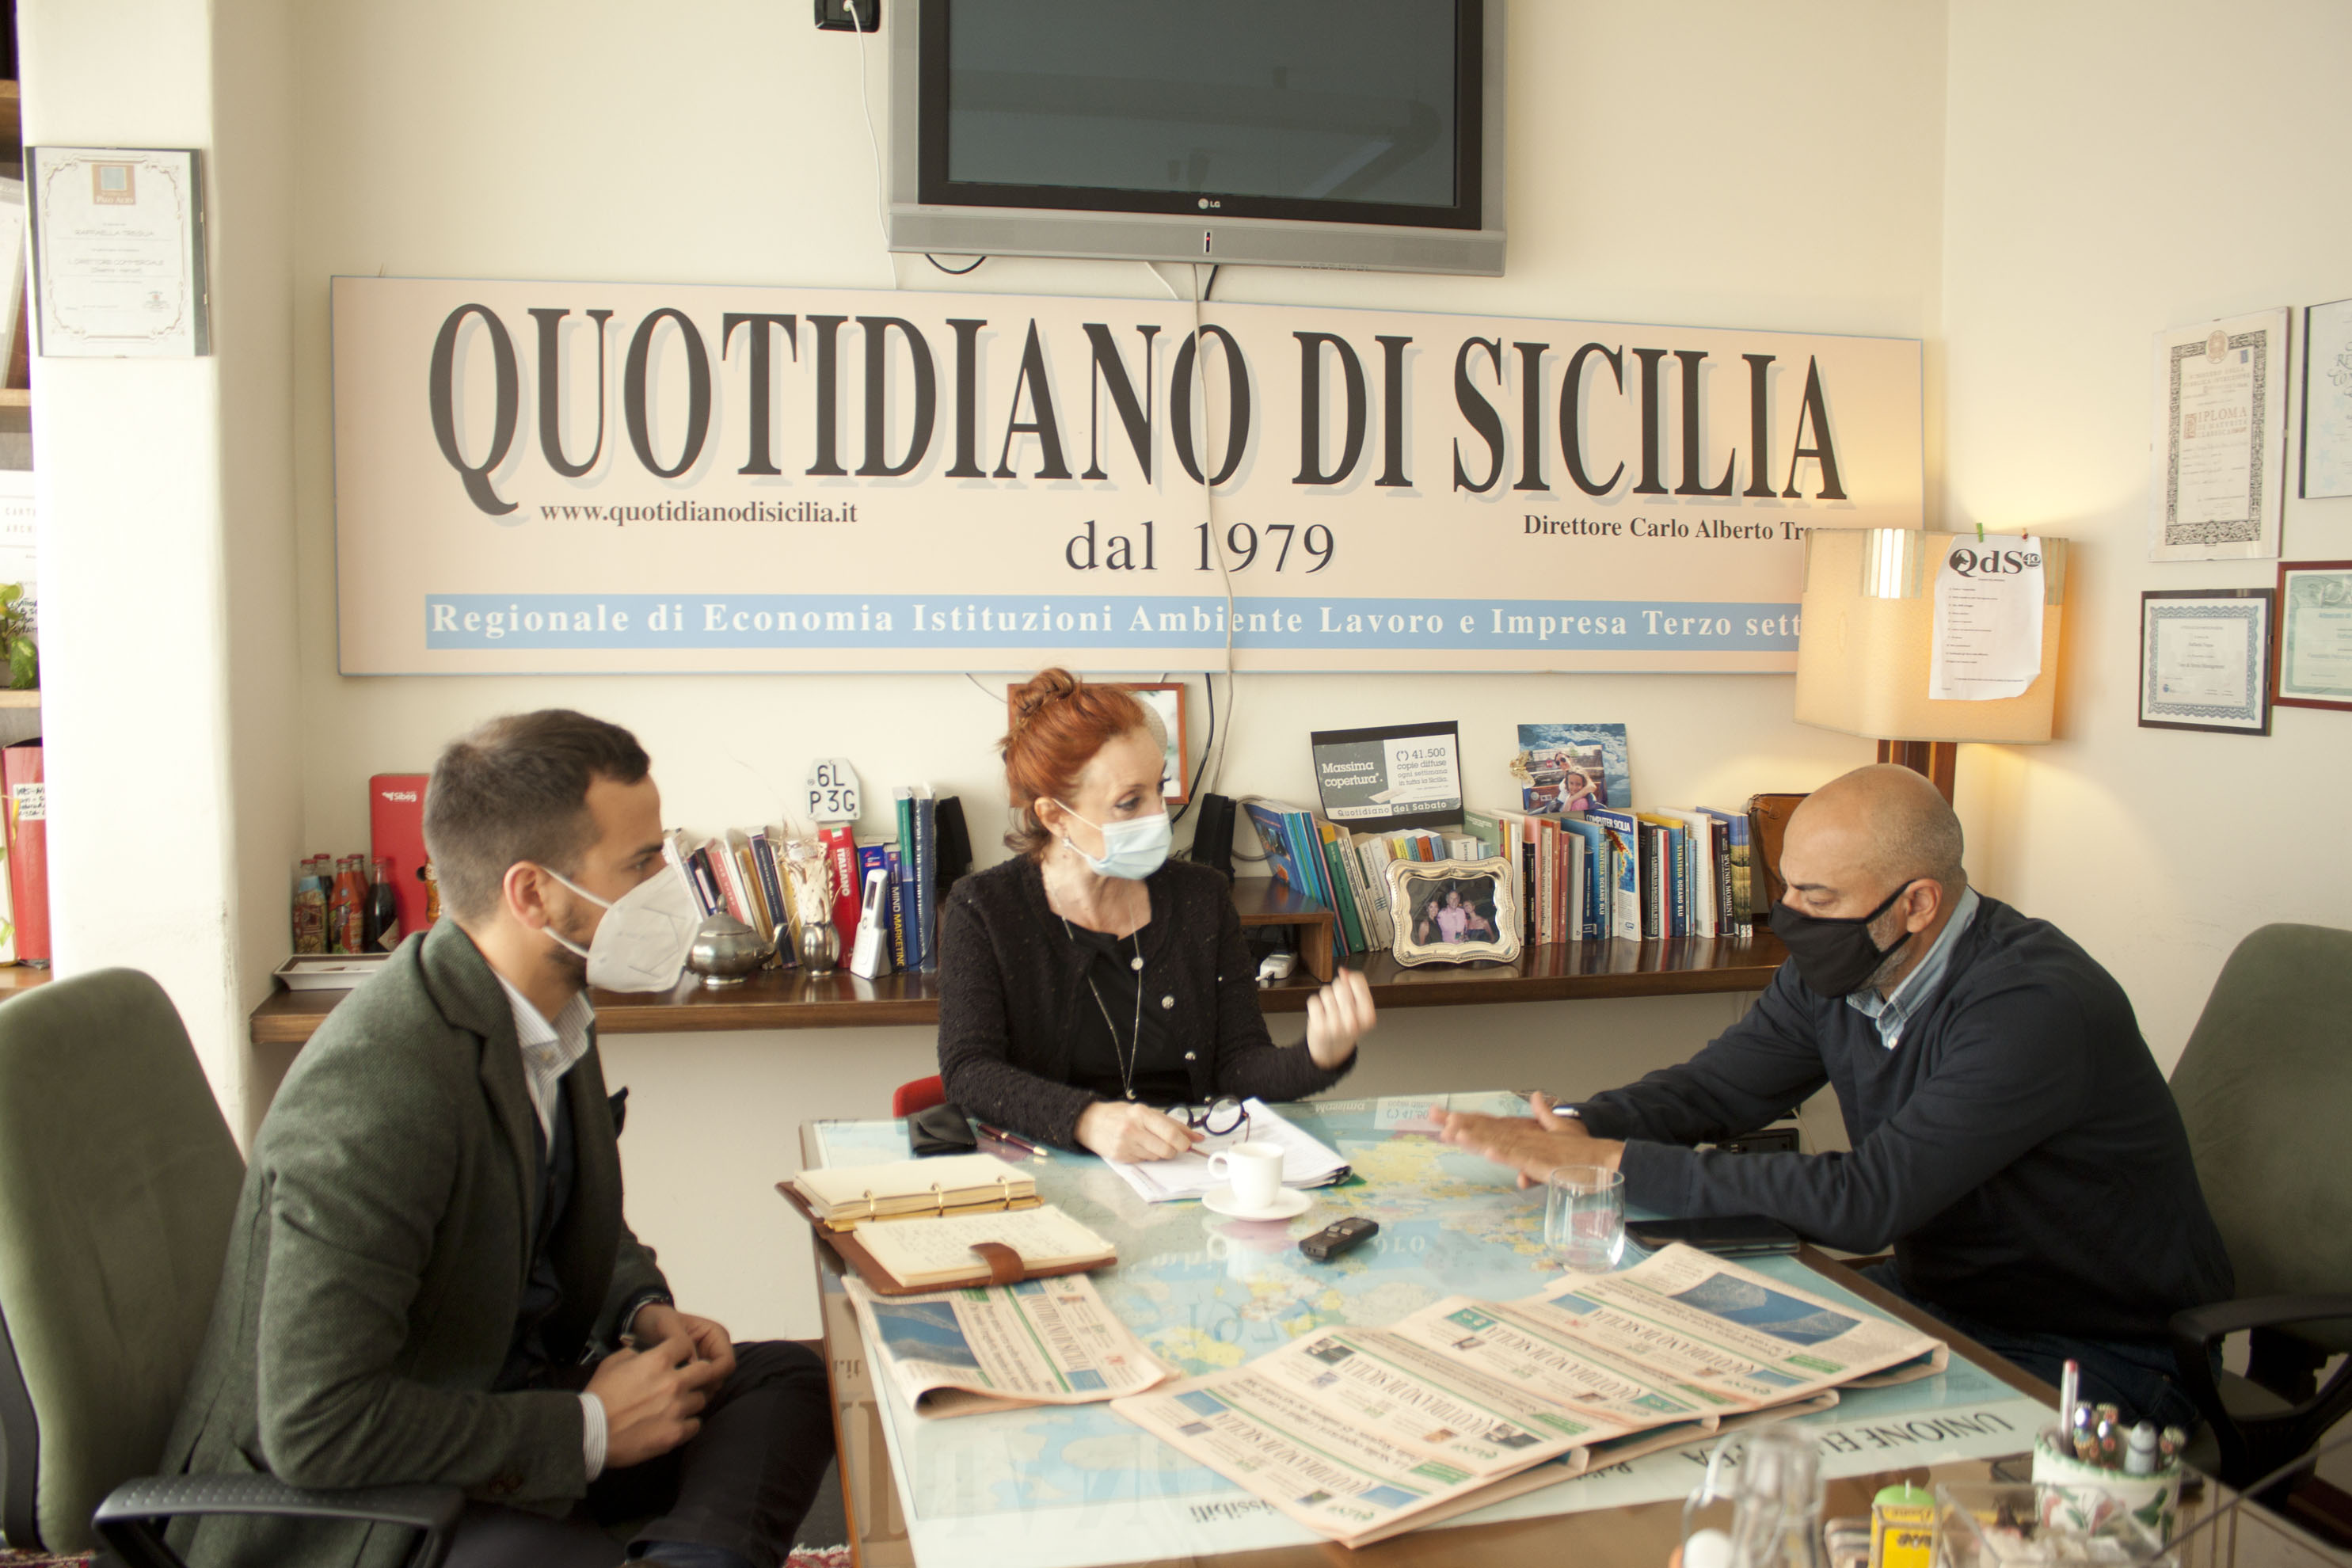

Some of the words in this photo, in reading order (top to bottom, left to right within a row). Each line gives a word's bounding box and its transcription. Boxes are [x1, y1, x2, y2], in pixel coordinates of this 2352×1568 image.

[429, 303, 1251, 516] QUOTIDIANO
[1292, 330, 1413, 489] DI
[1452, 337, 1848, 500] SICILIA
[539, 501, 858, 527] www.quotidianodisicilia.it
[1523, 514, 1622, 538] Direttore
[1629, 516, 1689, 539] Carlo
[1695, 519, 1773, 540] Alberto
[1065, 519, 1158, 571] dal
[1193, 521, 1335, 574] 1979
[1949, 547, 2023, 577] QdS
[431, 603, 630, 640] Regionale
[648, 603, 684, 632] di
[703, 603, 893, 632] Economia
[912, 603, 1113, 633] Istituzioni
[1129, 605, 1303, 634] Ambiente
[1319, 606, 1444, 634] Lavoro
[1460, 615, 1475, 634] e
[1490, 608, 1628, 641] Impresa
[1642, 610, 1732, 637] Terzo
[1396, 761, 1419, 771] copie
[1420, 759, 1447, 768] diffuse
[1412, 747, 1446, 759] 41.500
[816, 764, 846, 787] 6L
[1322, 760, 1374, 774] Massima
[1397, 770, 1413, 778] ogni
[1414, 767, 1448, 776] settimana
[1337, 807, 1390, 817] Quotidiano
[1393, 803, 1410, 813] del
[1412, 801, 1447, 811] Sabato
[1585, 814, 1614, 828] COMPUTER
[1613, 820, 1631, 832] SICILIA
[836, 848, 851, 896] ITALIANO
[891, 886, 900, 911] MIND
[1855, 1411, 2015, 1449] UNIONE
